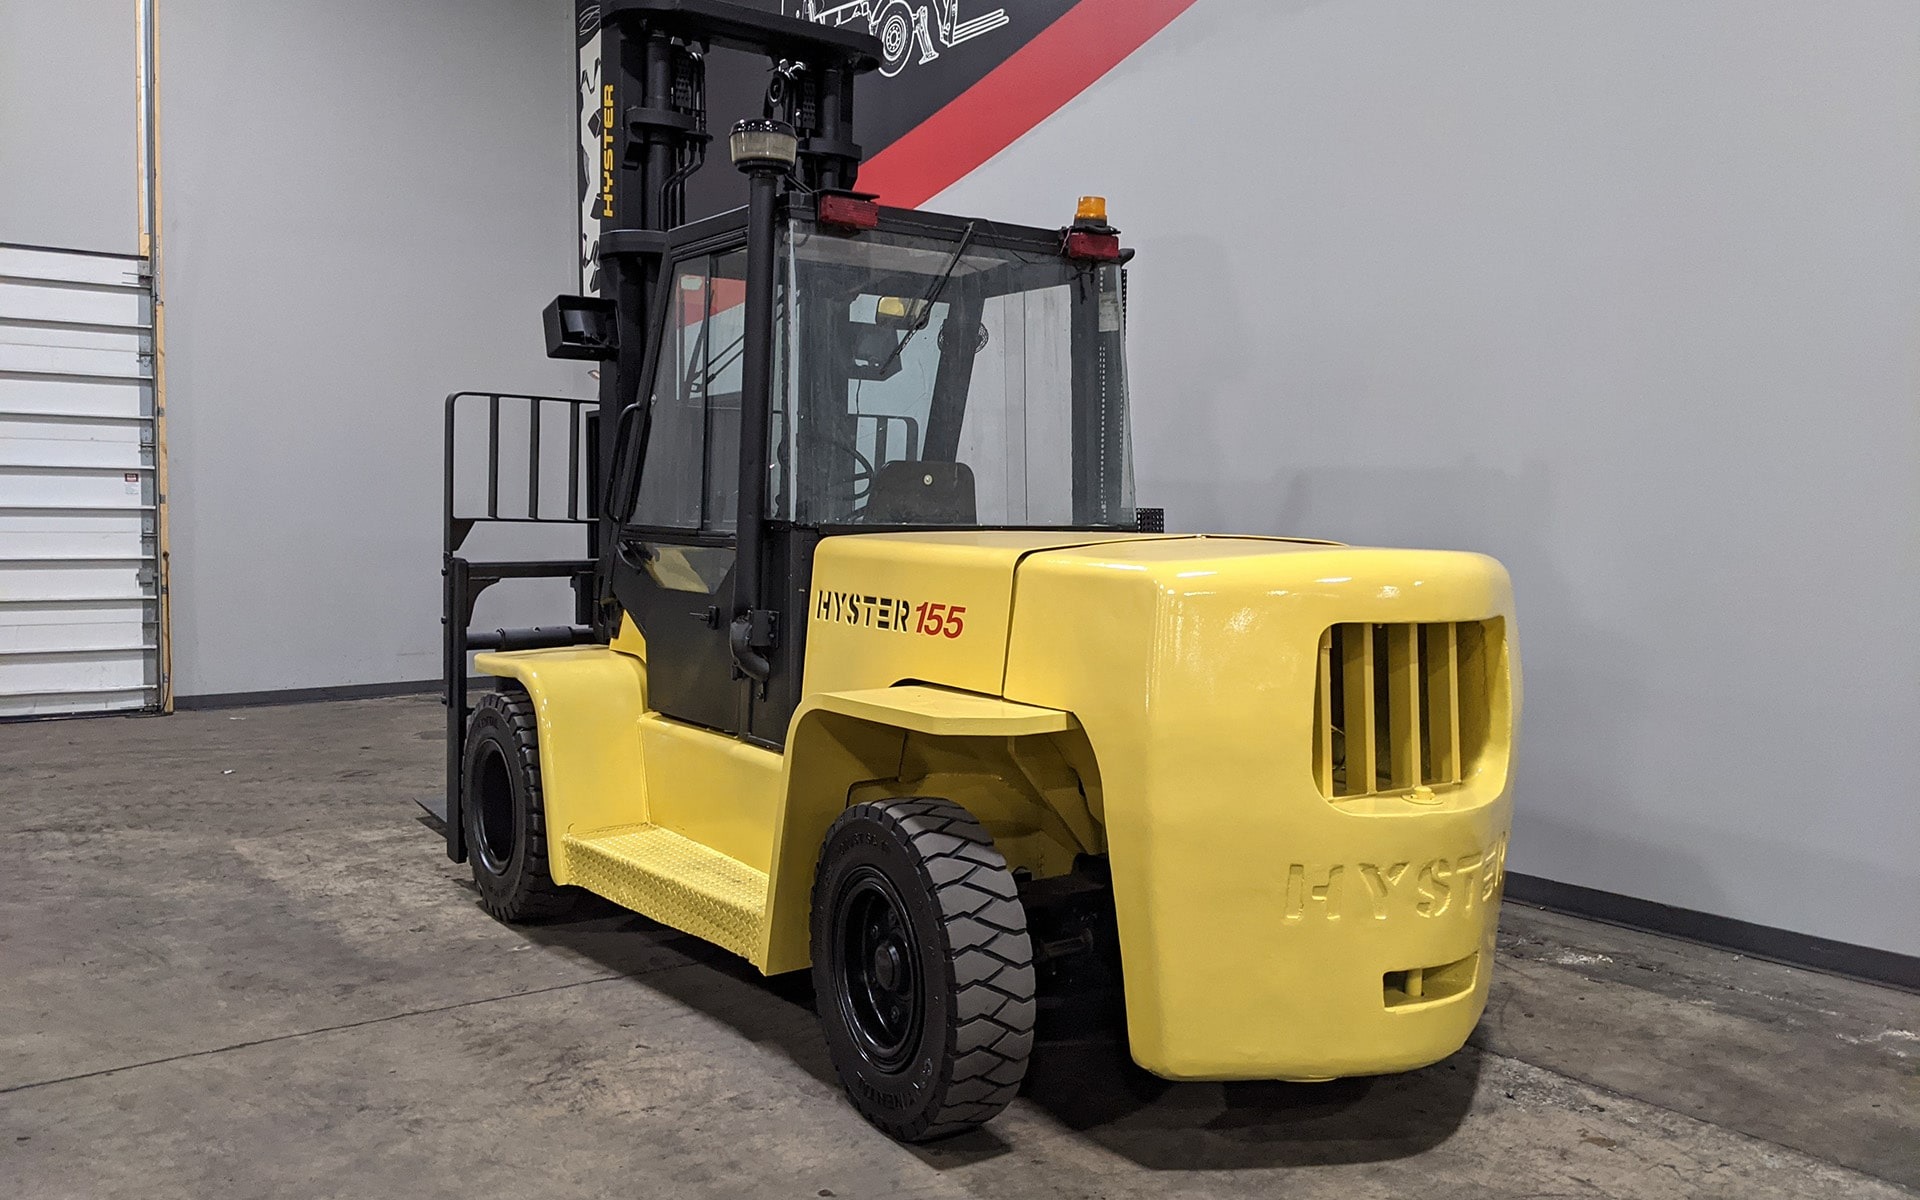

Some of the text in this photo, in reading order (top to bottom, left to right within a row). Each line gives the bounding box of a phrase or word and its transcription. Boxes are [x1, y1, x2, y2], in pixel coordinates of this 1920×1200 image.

[603, 84, 615, 218] HYSTER
[816, 589, 967, 640] HYSTER 155
